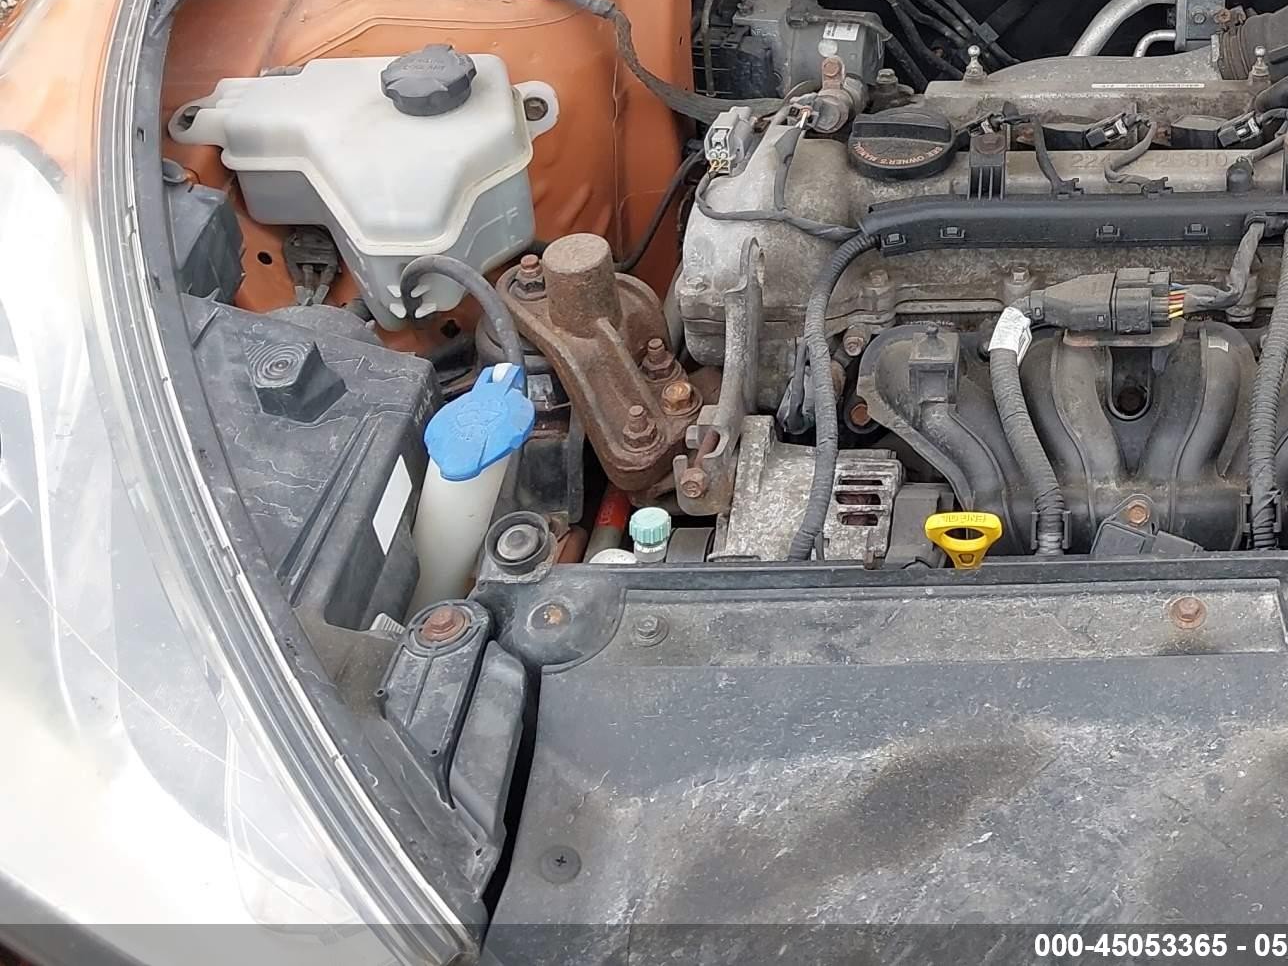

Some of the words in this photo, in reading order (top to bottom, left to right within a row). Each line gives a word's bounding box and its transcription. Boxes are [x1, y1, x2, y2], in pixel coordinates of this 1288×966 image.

[853, 141, 878, 162] MANUAL
[926, 146, 943, 158] SEE
[880, 155, 925, 165] OWNER'S
